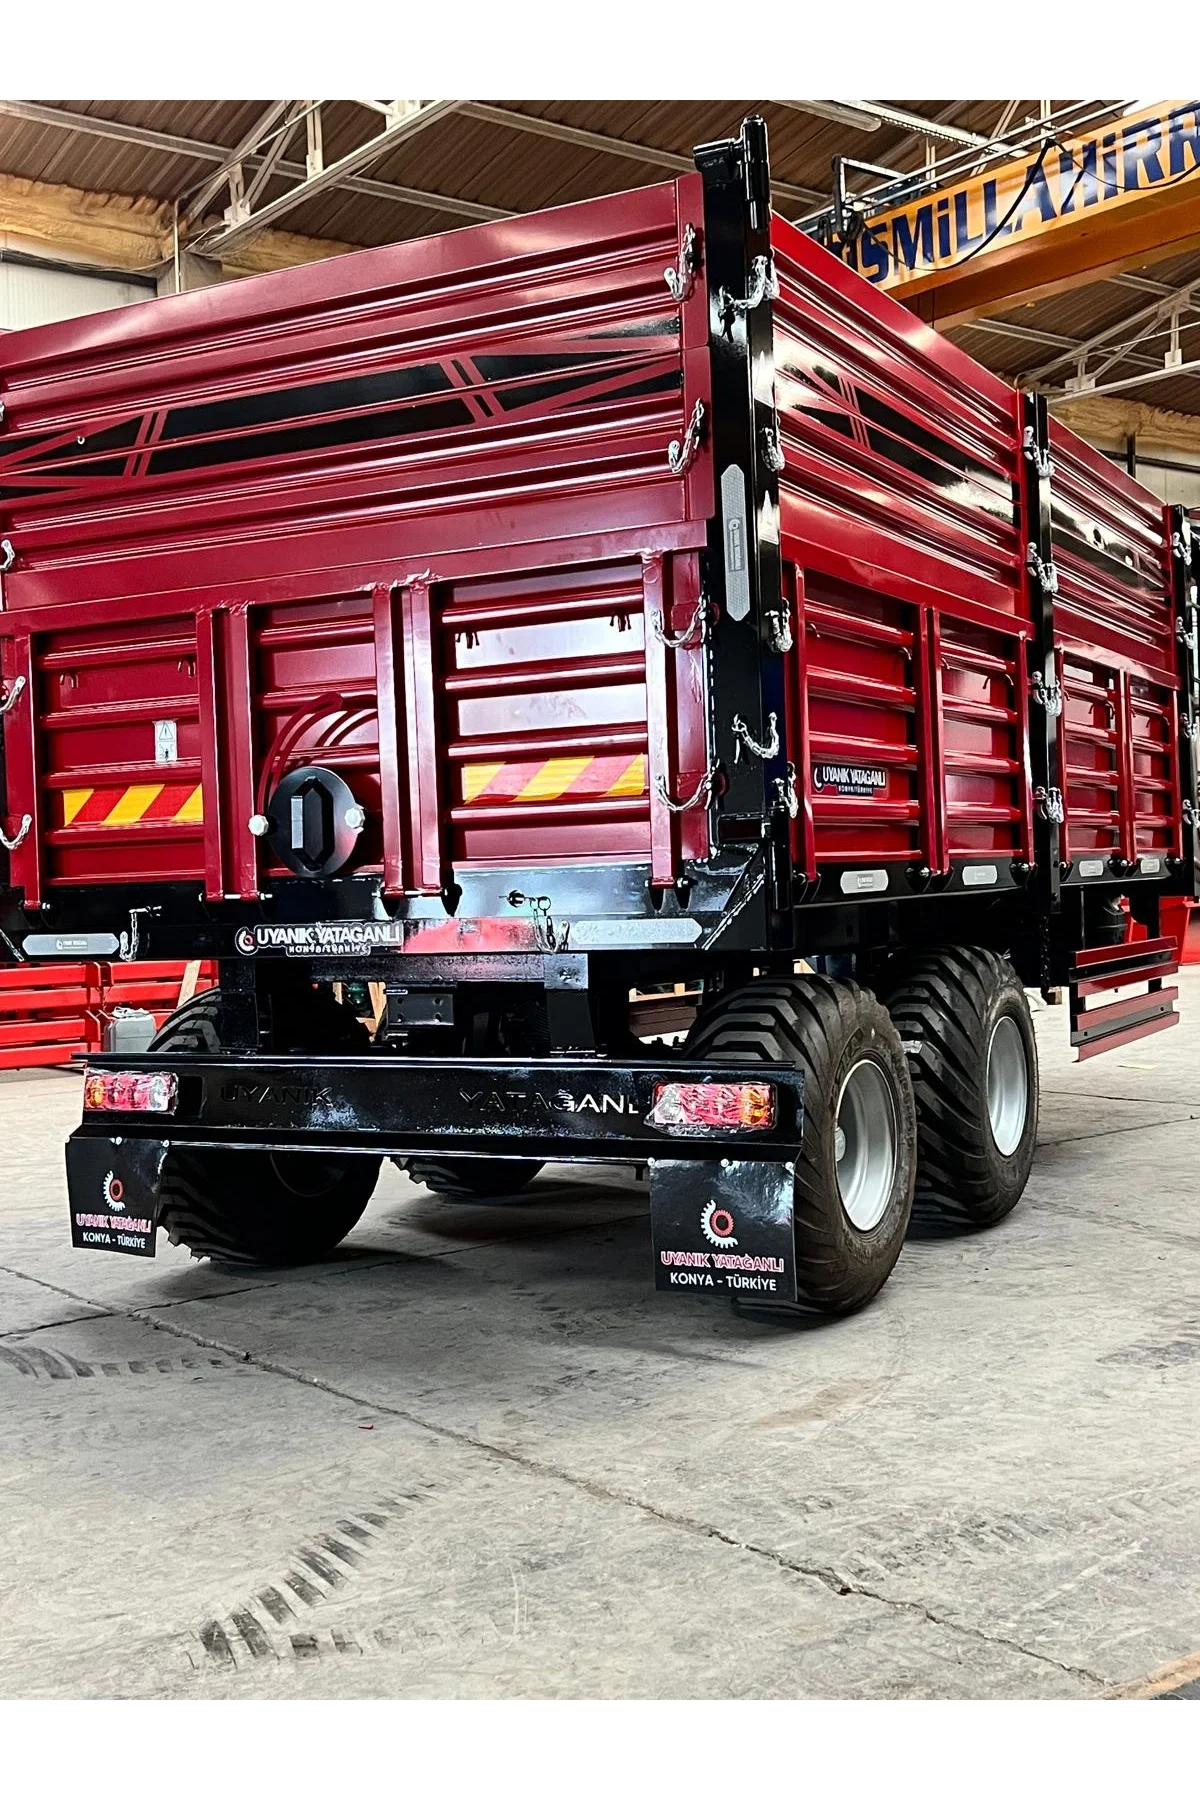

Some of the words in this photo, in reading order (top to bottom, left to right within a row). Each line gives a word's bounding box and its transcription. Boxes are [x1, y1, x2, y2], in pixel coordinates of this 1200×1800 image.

[256, 927, 315, 944] UYANIK
[221, 1084, 334, 1107] UYANIK
[83, 1231, 111, 1244] KONYA
[117, 1234, 146, 1249] TÜRKİYE
[661, 1251, 711, 1268] UYANIK
[711, 1253, 784, 1273] YATAĞANLI
[670, 1272, 714, 1286] KONYA
[726, 1274, 777, 1291] TÜRKİYE
